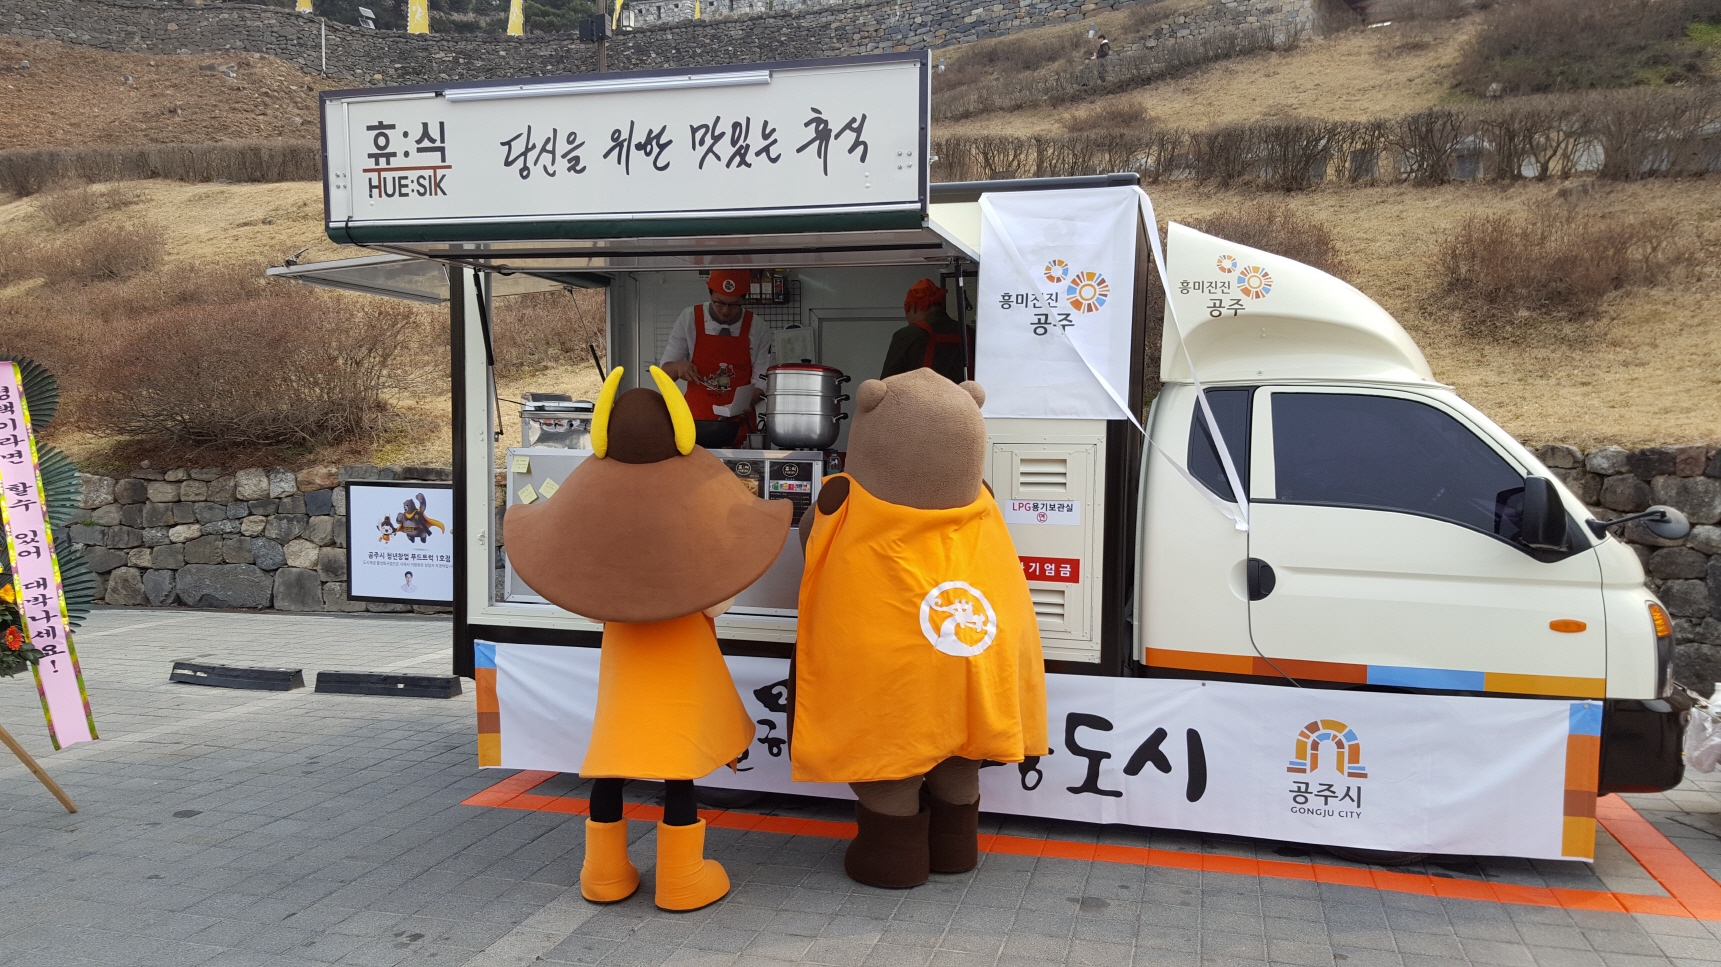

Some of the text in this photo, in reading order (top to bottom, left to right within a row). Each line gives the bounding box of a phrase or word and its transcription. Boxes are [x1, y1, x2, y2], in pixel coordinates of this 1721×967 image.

[366, 120, 446, 166] 휴:식
[500, 106, 869, 180] 당신을 위한 맛있는 휴식
[368, 173, 448, 199] HUE:SIK
[1178, 279, 1231, 295] 흥미진진
[998, 291, 1059, 310] 흥미진진
[1206, 298, 1246, 318] 공주
[1029, 313, 1075, 336] 공주
[1012, 502, 1073, 512] LPG용기보관실
[14, 529, 42, 560] 있어
[368, 551, 385, 560] 공주시
[1020, 561, 1072, 577] 기엄금
[1288, 780, 1362, 809] 공주시
[1290, 806, 1362, 819] GONGJU CITY
